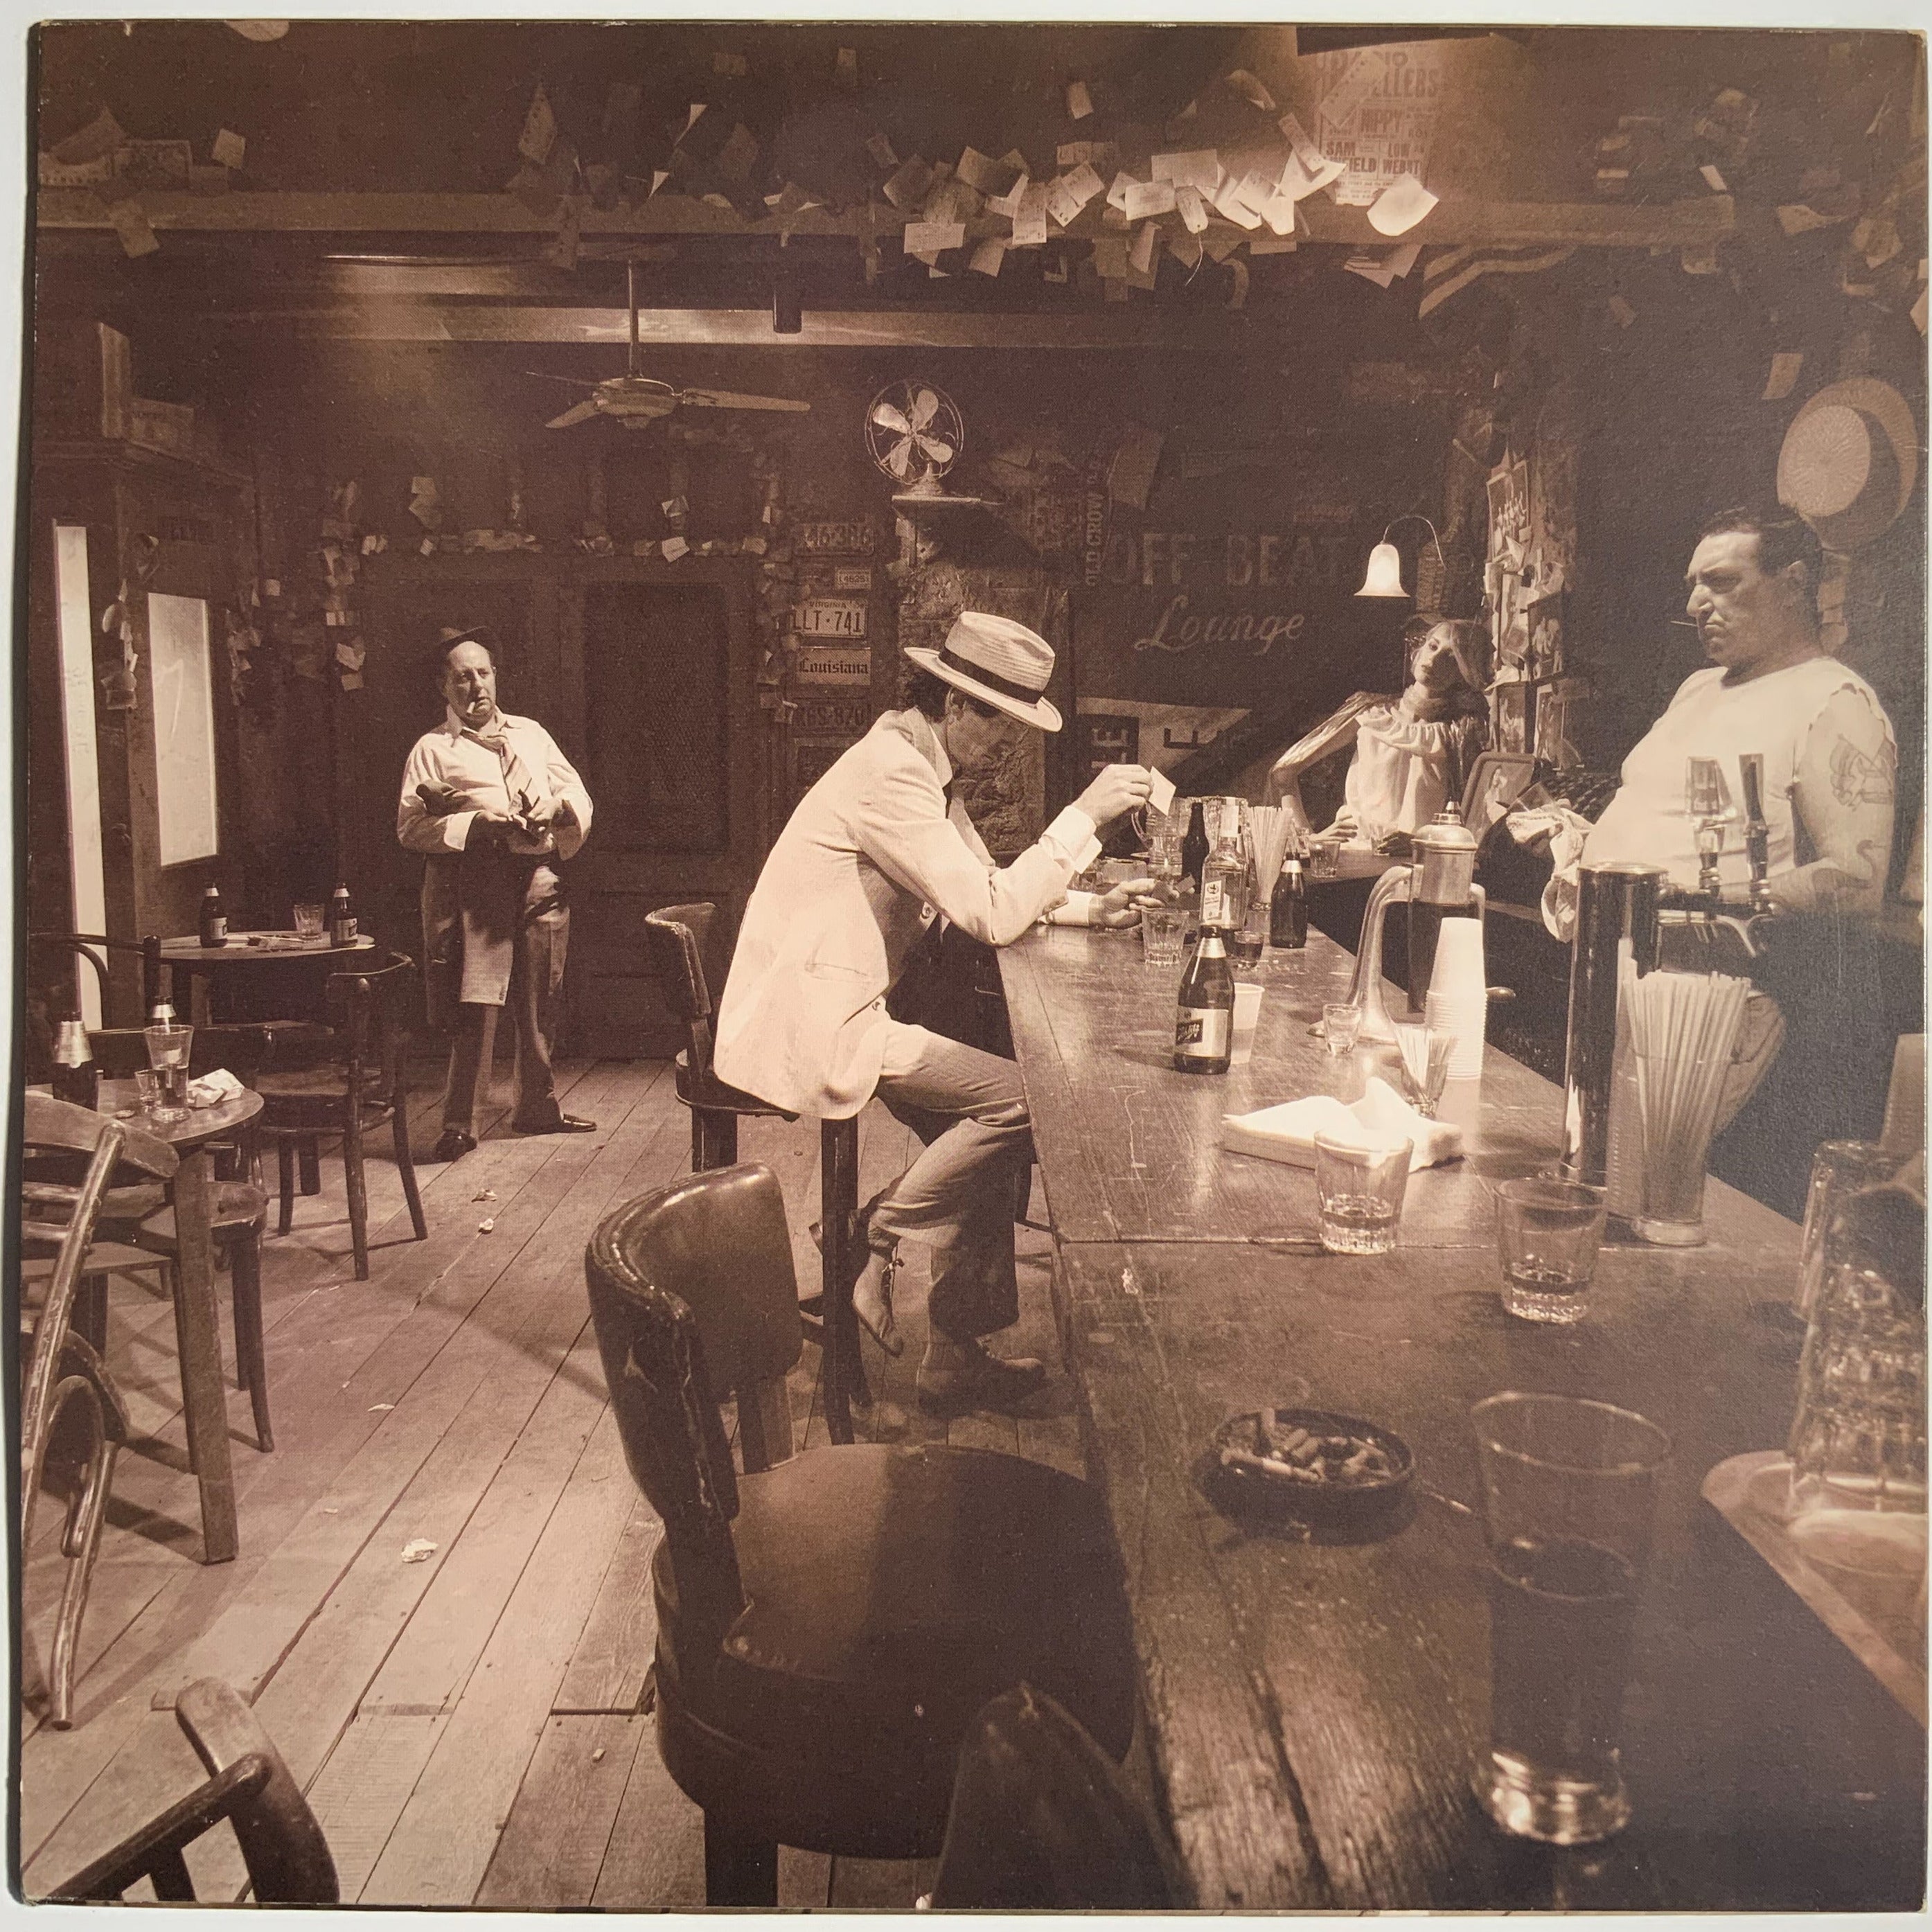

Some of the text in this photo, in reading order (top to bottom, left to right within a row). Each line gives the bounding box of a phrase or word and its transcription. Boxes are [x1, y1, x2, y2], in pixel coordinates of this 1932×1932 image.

[1326, 141, 1356, 157] SAM
[1085, 490, 1105, 547] CROW
[1085, 551, 1102, 587] OLD
[1106, 533, 1348, 586] OFF BEAT
[1133, 594, 1305, 657] Lounge
[799, 657, 869, 674] Louisiana
